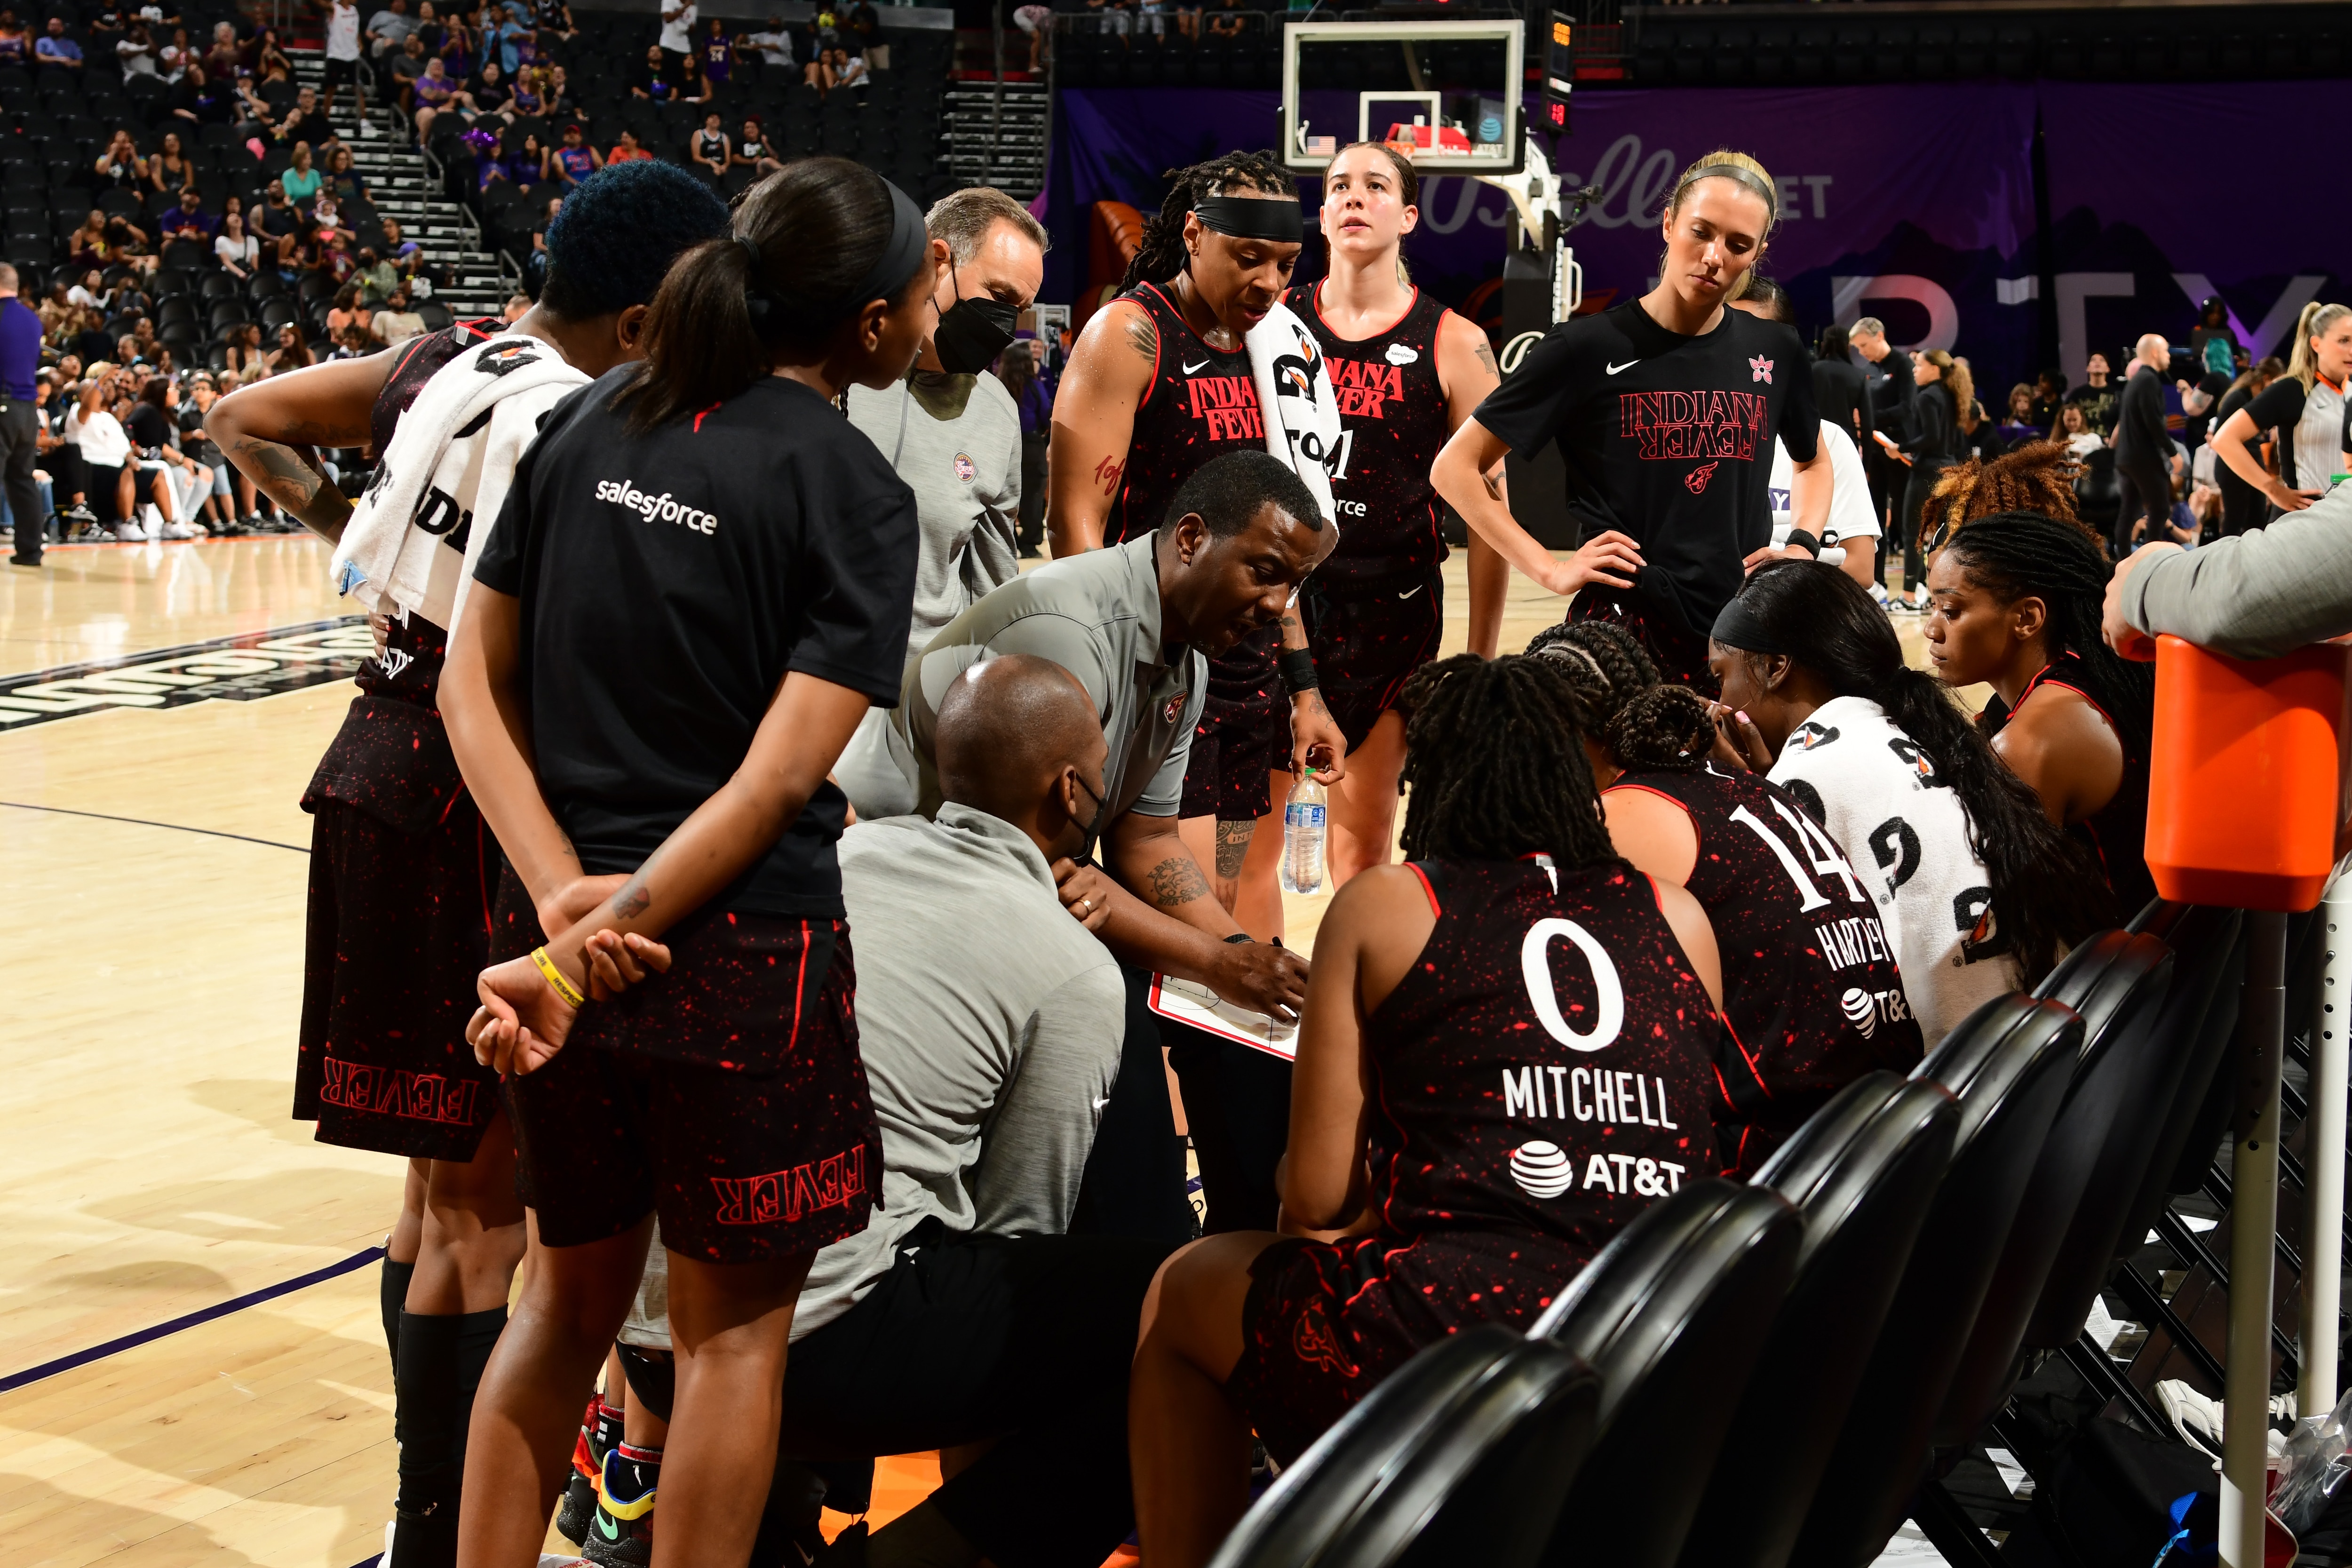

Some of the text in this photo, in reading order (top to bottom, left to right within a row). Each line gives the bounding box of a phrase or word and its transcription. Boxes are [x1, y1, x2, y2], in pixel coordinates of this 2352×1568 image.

[1619, 391, 1768, 440] INDIANA
[1634, 424, 1758, 462] FEVER
[595, 479, 718, 535] salesforce
[1728, 794, 1866, 913] 14
[1521, 917, 1624, 1052] 0
[321, 1056, 480, 1126] FEVER
[1502, 1065, 1678, 1130] MITCHELL
[710, 1143, 866, 1224] FEVER
[1582, 1154, 1686, 1197] AT&T
